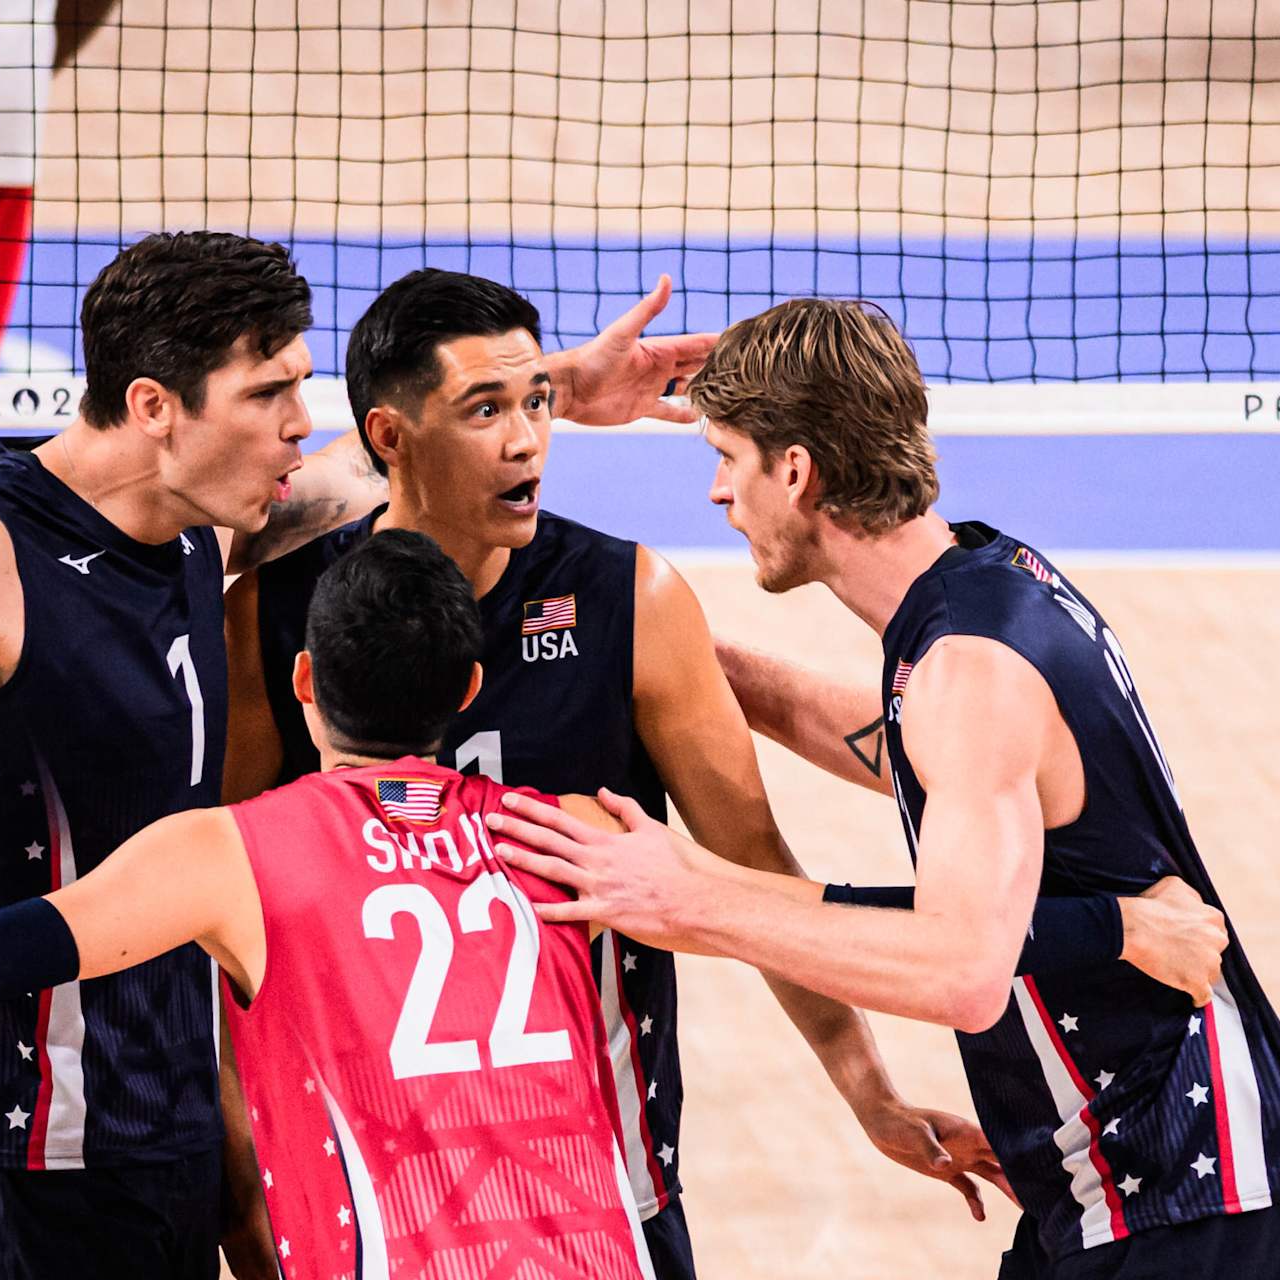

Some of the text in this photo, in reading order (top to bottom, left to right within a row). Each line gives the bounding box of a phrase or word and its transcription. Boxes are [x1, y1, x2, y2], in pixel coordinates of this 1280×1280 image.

[166, 633, 205, 787] 1
[521, 630, 579, 664] USA
[361, 870, 573, 1081] 22
